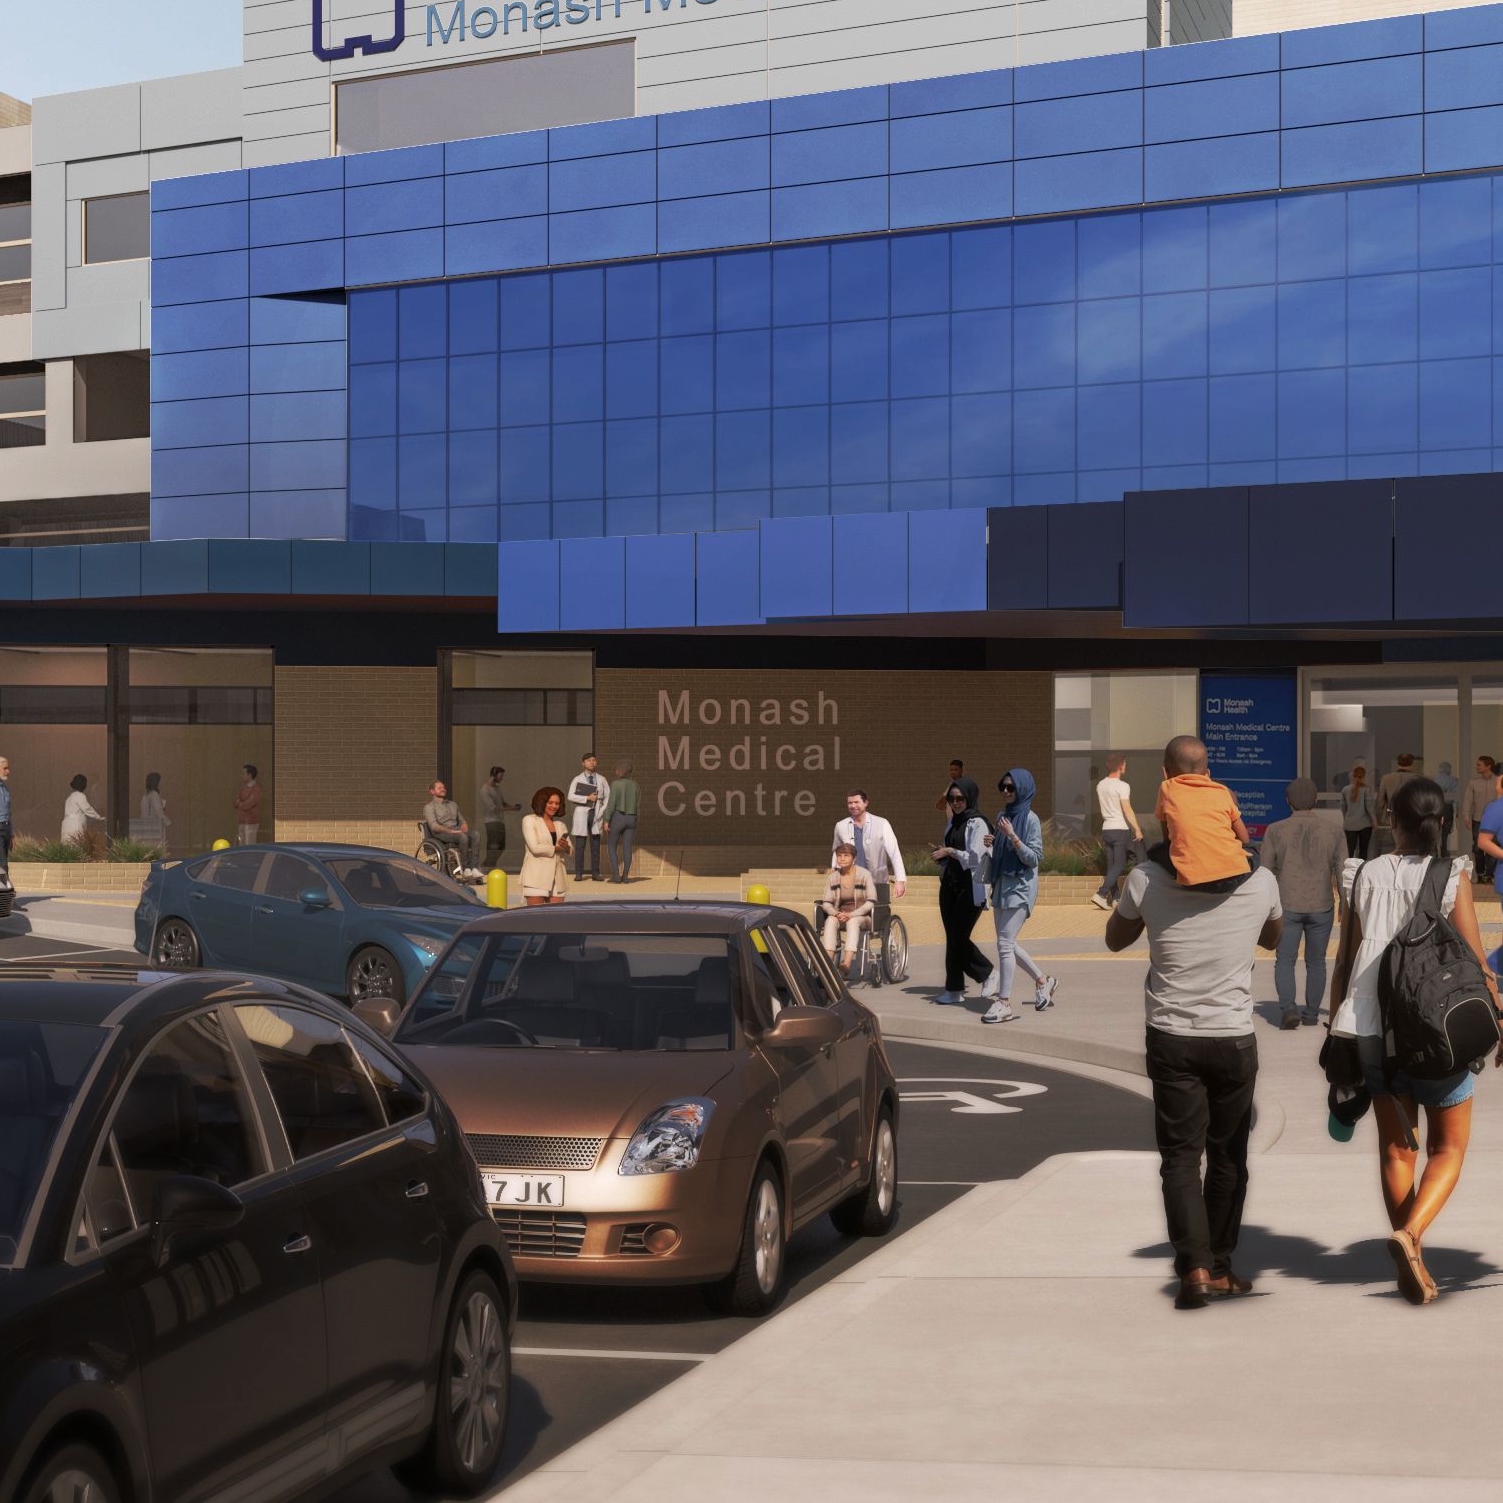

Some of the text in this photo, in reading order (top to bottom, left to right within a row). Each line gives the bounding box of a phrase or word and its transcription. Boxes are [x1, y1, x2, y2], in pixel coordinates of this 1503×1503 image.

[658, 689, 839, 725] Monash
[1223, 698, 1254, 707] Monash
[1223, 706, 1248, 714] Health
[1205, 722, 1291, 732] Monash Medical Centre
[1205, 732, 1258, 741] Main Entrance
[658, 735, 841, 771] Medical
[657, 781, 816, 816] Centre
